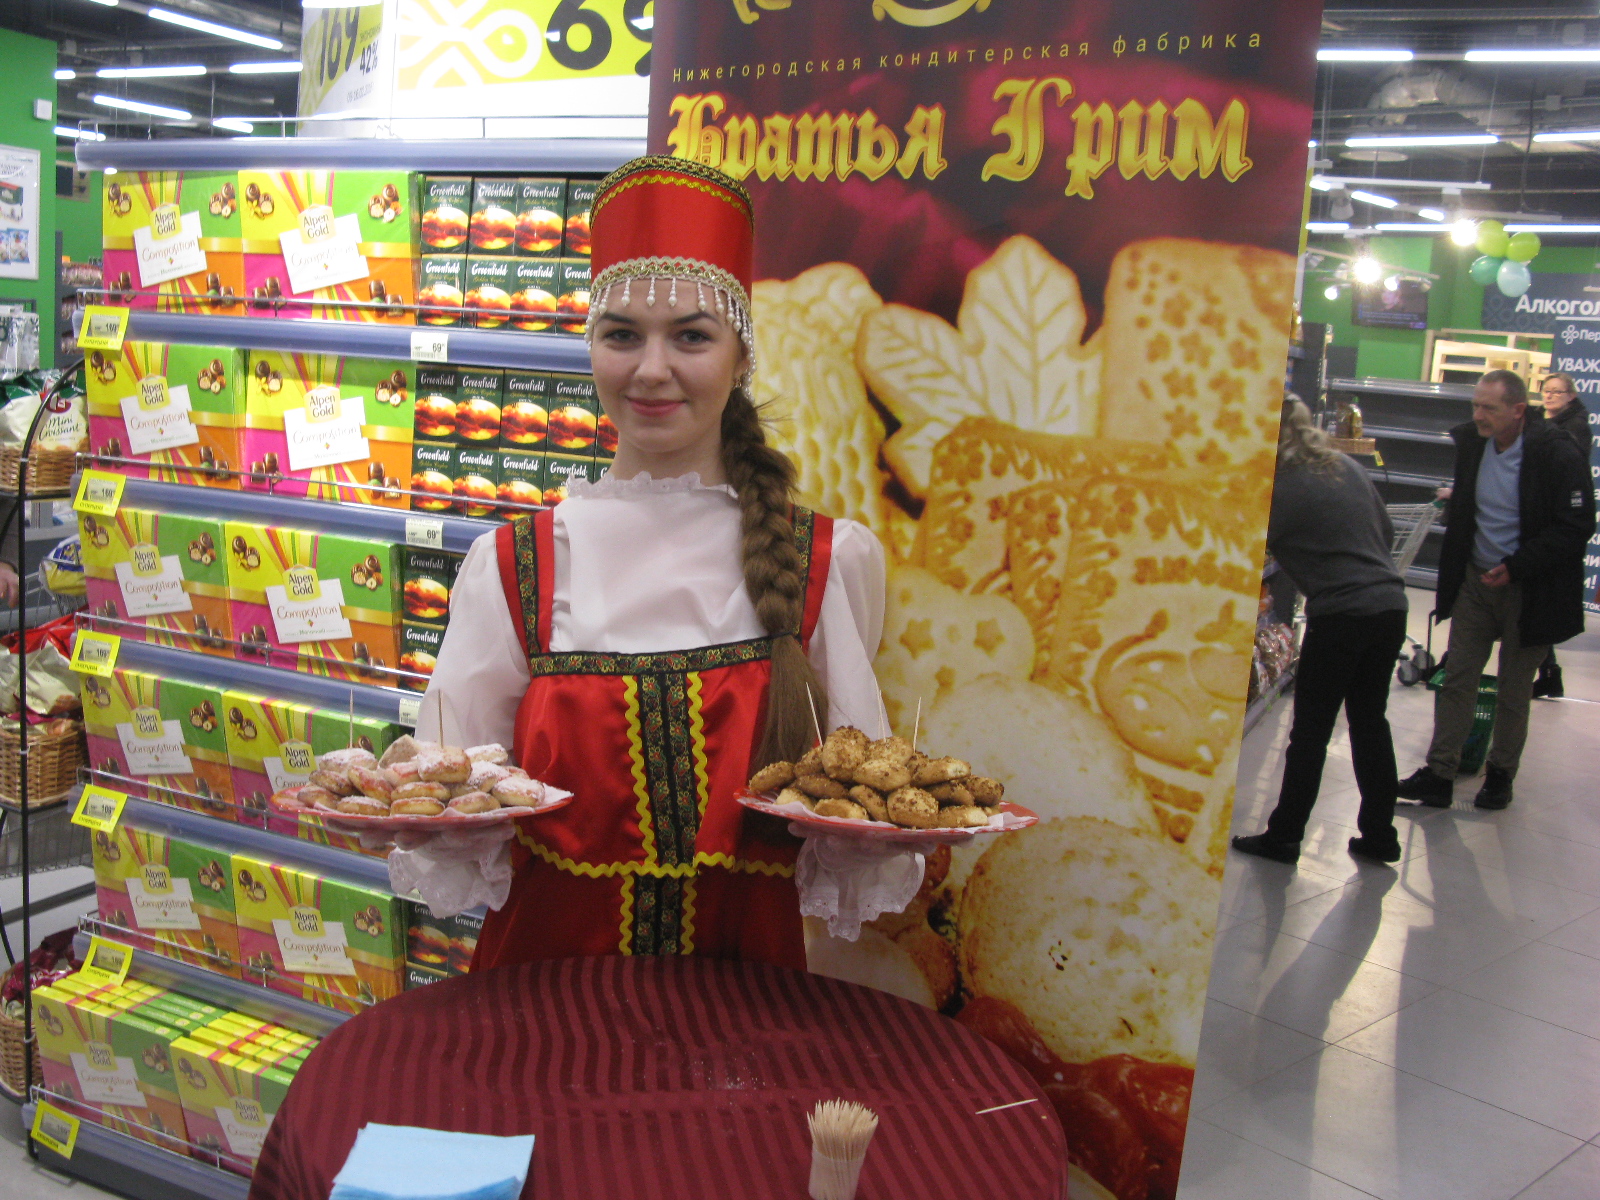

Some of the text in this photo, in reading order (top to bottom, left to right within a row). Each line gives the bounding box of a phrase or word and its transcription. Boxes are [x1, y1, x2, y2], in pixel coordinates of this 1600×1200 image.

[672, 32, 1261, 82] Нижегородская кондитерская фабрика
[667, 75, 1252, 199] Братья Грим
[430, 185, 465, 196] Greenfield
[523, 186, 560, 198] Greenfield
[155, 211, 176, 225] Alpen
[303, 214, 329, 228] Alpen
[157, 222, 176, 235] Gold
[308, 225, 329, 238] Gold
[142, 240, 196, 261] Composition
[426, 261, 460, 274] Greenfield
[472, 263, 508, 276] Greenfield
[517, 265, 554, 278] Greenfield
[420, 373, 455, 386] Greenfield
[463, 376, 498, 389] Greenfield
[510, 378, 545, 391] Greenfield
[141, 382, 164, 396] Alpen
[557, 382, 594, 396] Greenfield
[145, 393, 164, 405] Gold
[310, 395, 336, 408] Alpen
[313, 405, 335, 418] Gold
[48, 415, 73, 428] Mini
[130, 412, 185, 430] Composition
[417, 448, 450, 462] Greenfield
[460, 452, 494, 466] Greenfield
[503, 457, 539, 471] Greenfield
[550, 462, 587, 476] Greenfield
[134, 551, 156, 563] Alpen
[411, 555, 444, 569] Greenfield
[138, 560, 156, 572] Gold
[289, 574, 314, 585] Alpen
[125, 579, 178, 594] Composition
[293, 583, 313, 596] Gold
[276, 606, 338, 620] Composition
[407, 628, 439, 643] Greenfield
[135, 712, 158, 724] Alpen
[139, 722, 158, 733] Gold
[126, 741, 180, 754] Composition
[285, 746, 309, 759] Alpen
[289, 756, 309, 768] Gold
[145, 868, 167, 879] Alpen
[149, 879, 167, 889] Gold
[294, 911, 318, 922] Alpen
[298, 920, 318, 932] Gold
[283, 937, 341, 953] Composition
[93, 1055, 111, 1066] Gold
[236, 1100, 258, 1112] Alpen
[240, 1110, 260, 1122] Gold
